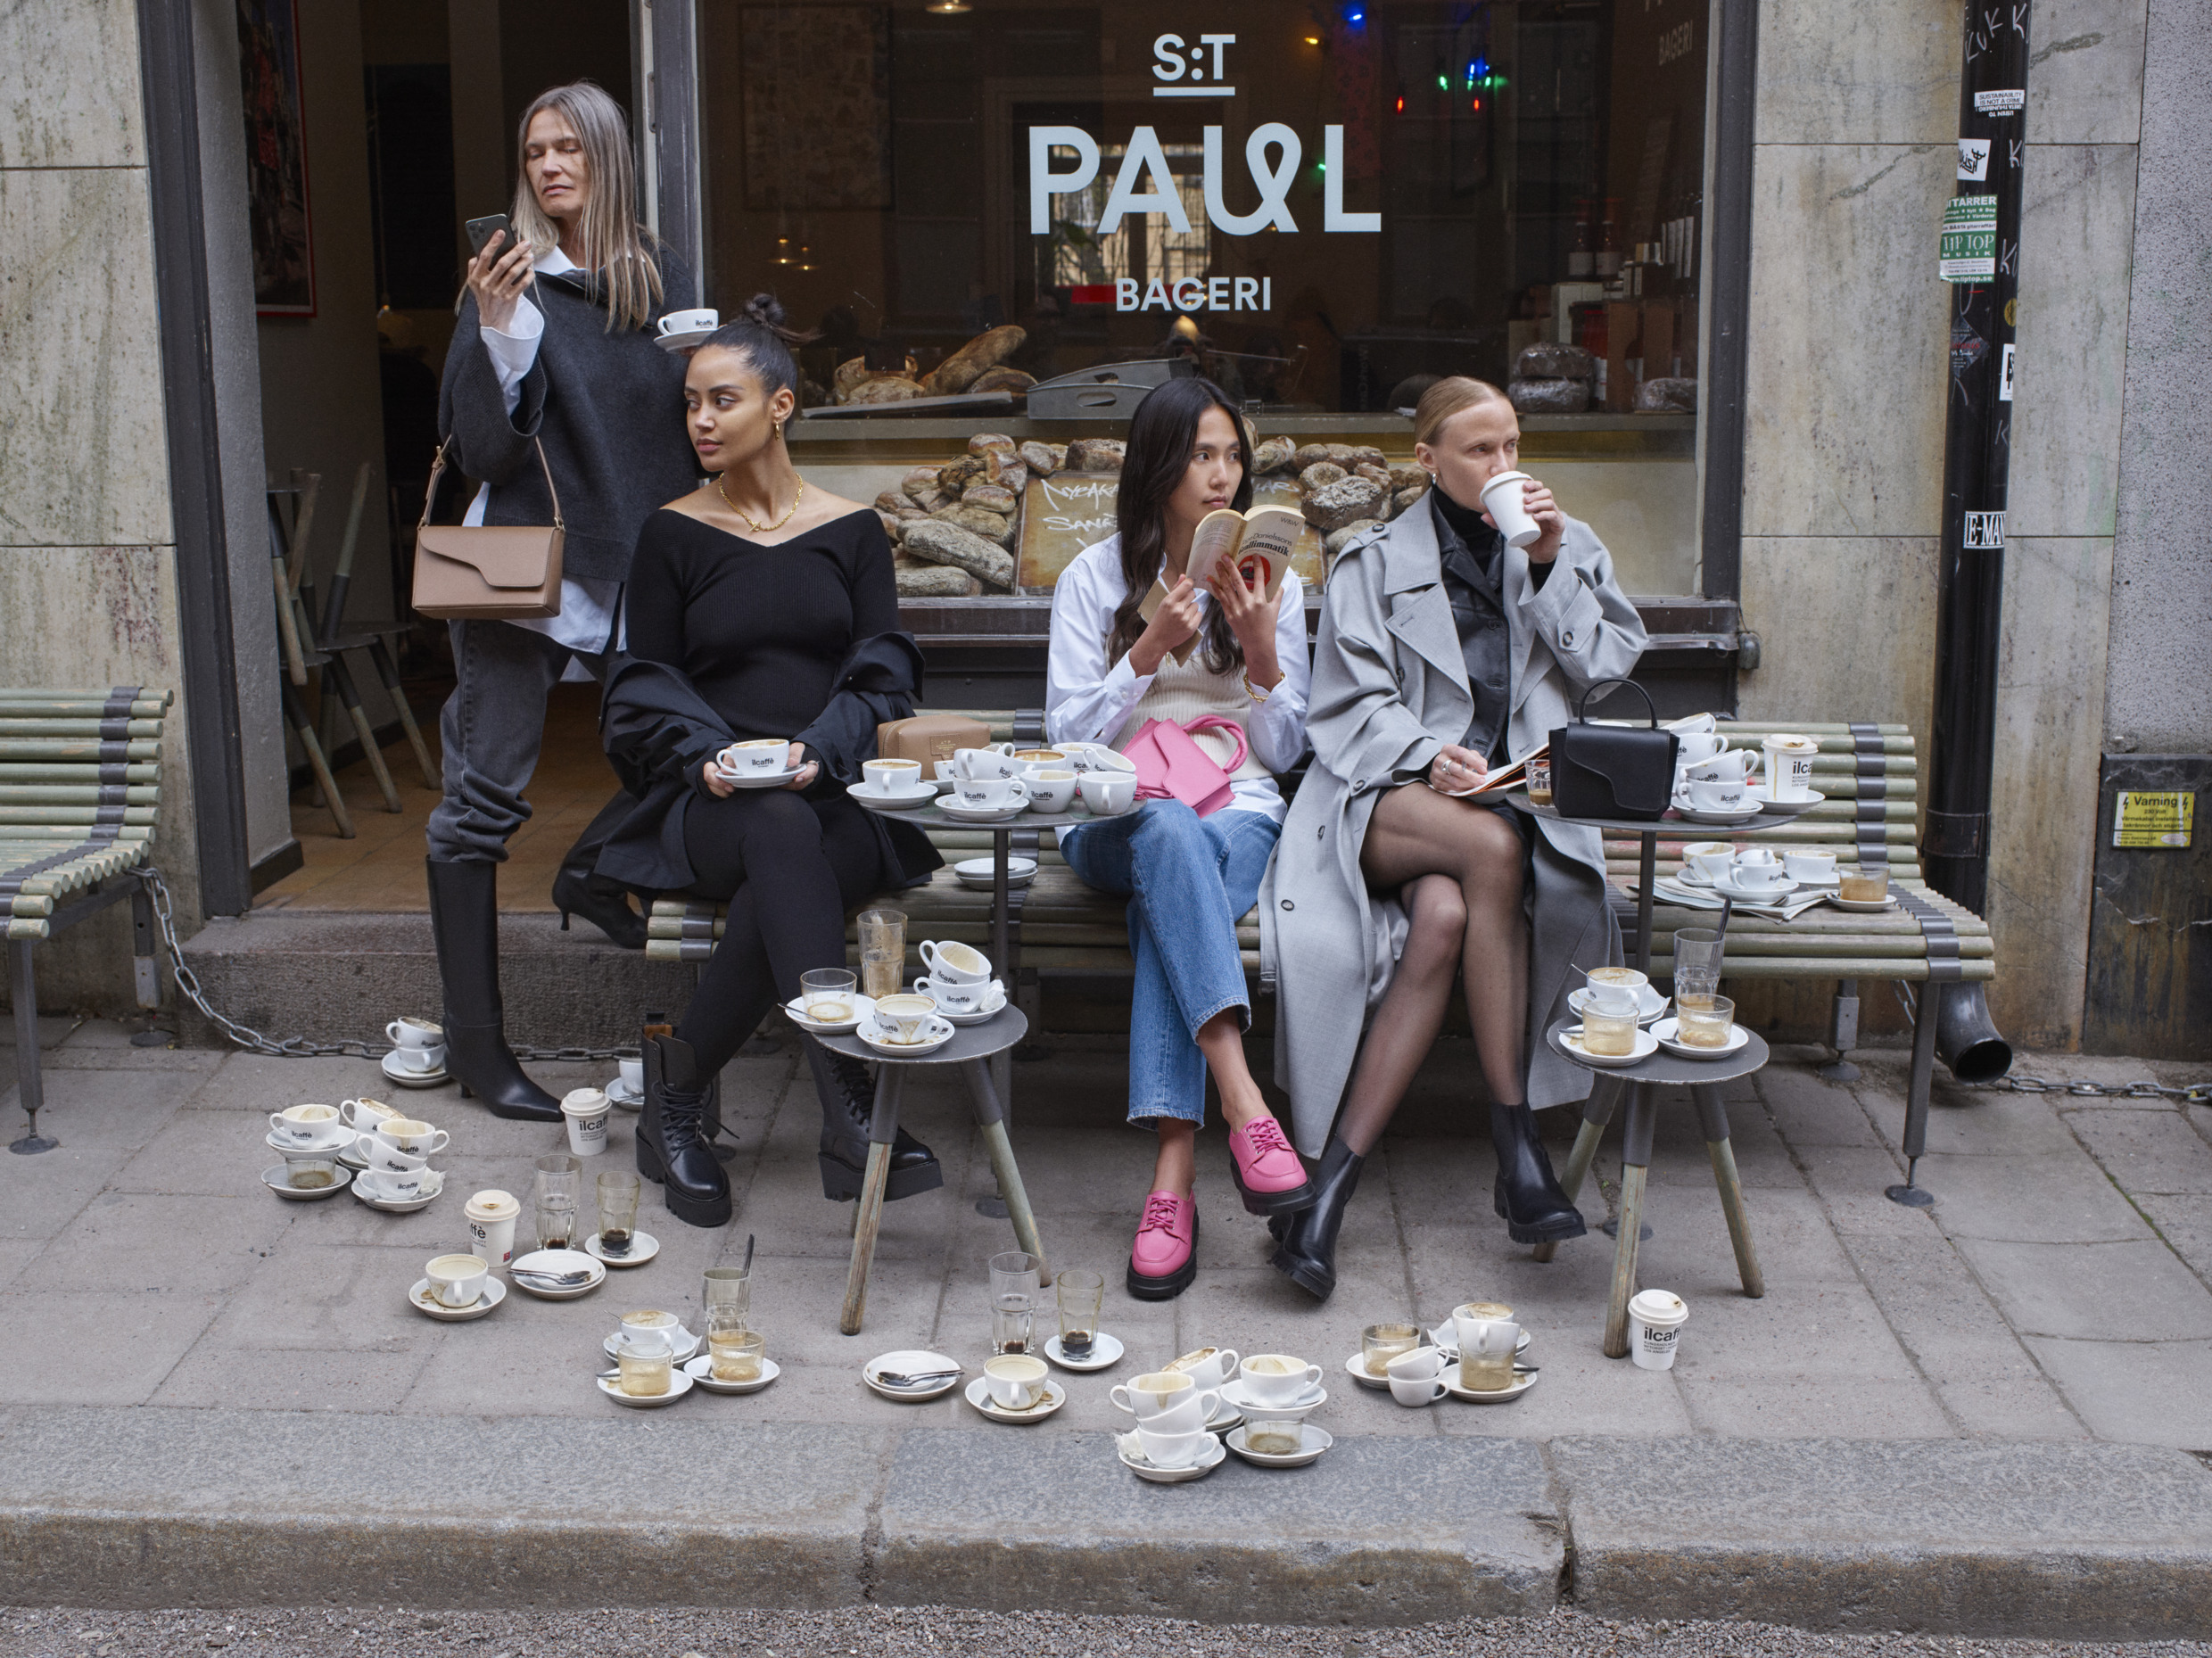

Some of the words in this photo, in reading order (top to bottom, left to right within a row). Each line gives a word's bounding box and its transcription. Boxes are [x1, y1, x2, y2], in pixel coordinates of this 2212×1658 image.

[1659, 20, 1693, 66] BAGERI
[1152, 34, 1236, 81] S:T
[1028, 122, 1382, 235] PAUL
[1942, 235, 1963, 252] TIP
[1965, 234, 1995, 250] TOP
[1115, 276, 1271, 312] BAGERI
[751, 757, 774, 766] ilcaffè
[964, 792, 986, 800] ilcaffè
[1031, 790, 1053, 799] ilcaffè
[2134, 796, 2178, 808] Varning
[946, 995, 970, 1003] ilcaffè
[291, 1130, 312, 1138] ilcaffè
[397, 1145, 419, 1153] ilcaffè
[398, 1182, 418, 1190] ilcaffè
